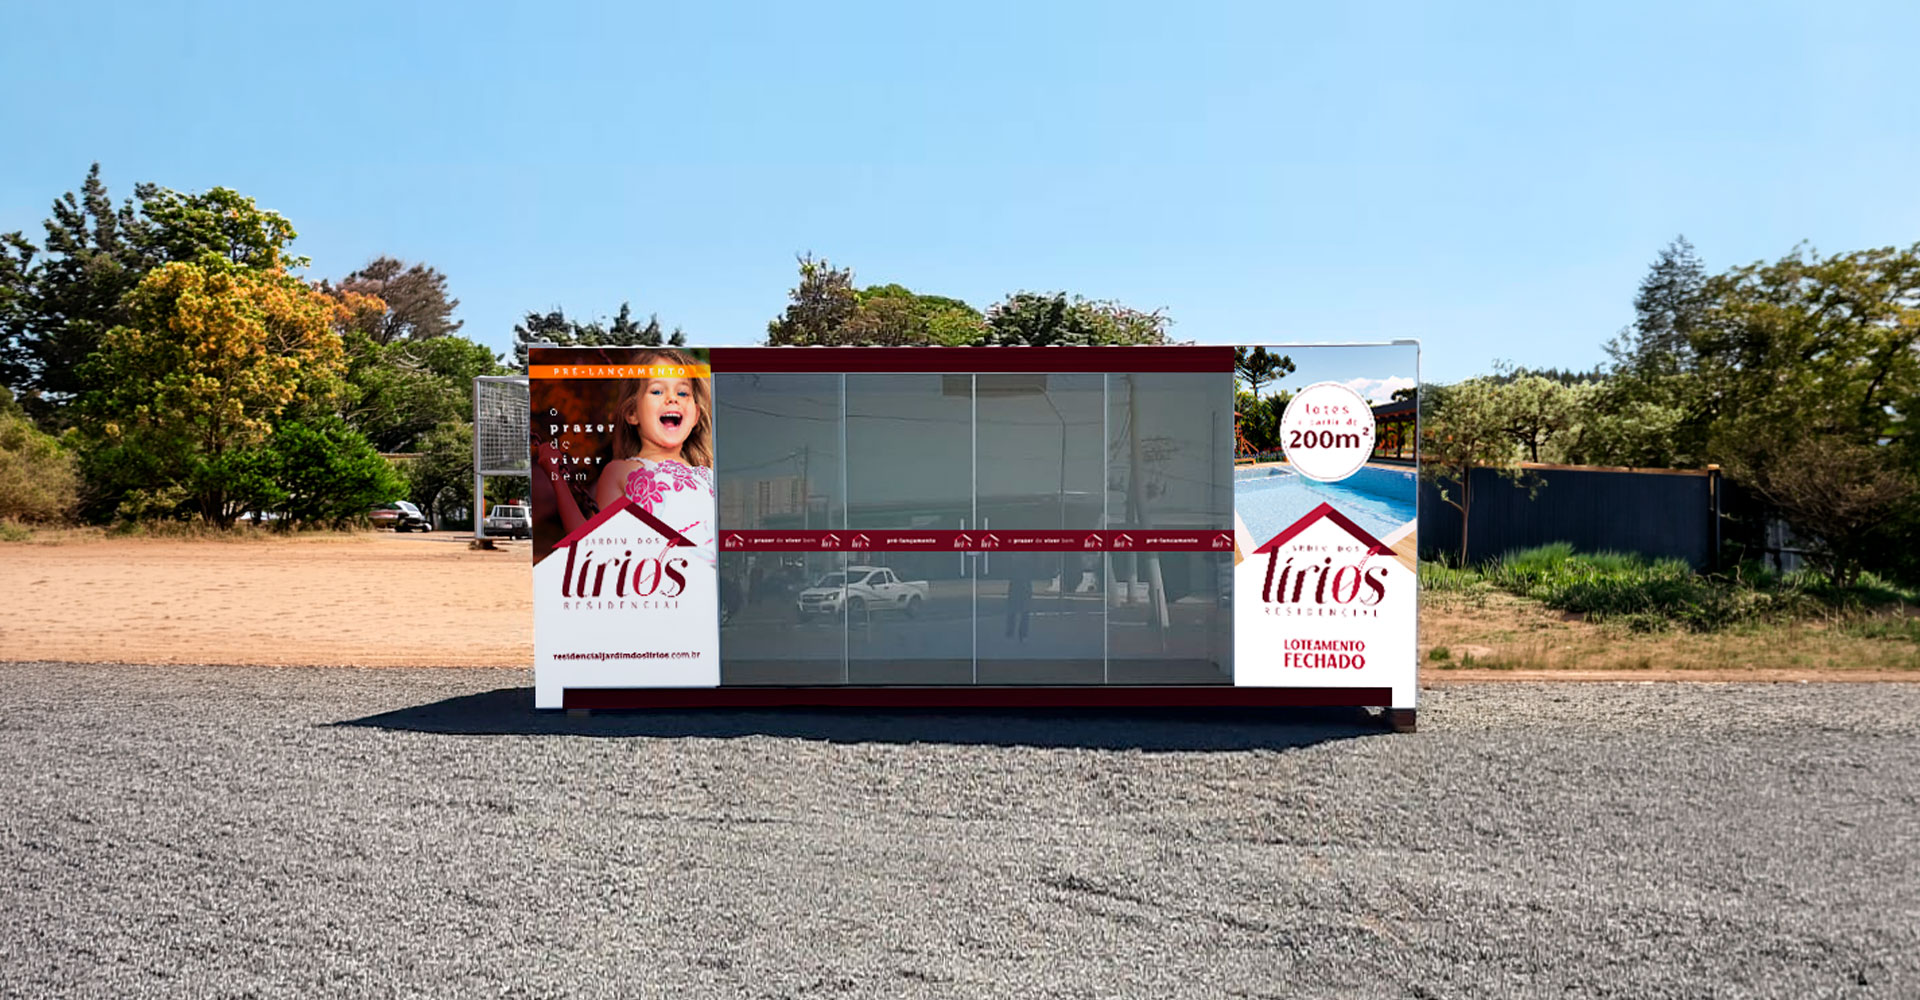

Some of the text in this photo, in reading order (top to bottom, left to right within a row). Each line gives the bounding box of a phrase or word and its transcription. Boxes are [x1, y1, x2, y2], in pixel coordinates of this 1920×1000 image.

[553, 367, 685, 377] PRÉ-LANÇAMENTO
[550, 408, 558, 417] o
[1305, 403, 1350, 415] lotes
[550, 424, 615, 434] prazer
[550, 438, 570, 450] de
[550, 456, 602, 465] viver
[551, 472, 587, 481] bem
[637, 537, 660, 545] DOS
[1284, 639, 1365, 652] LOTEAMENTO
[1284, 652, 1365, 669] FECHADO
